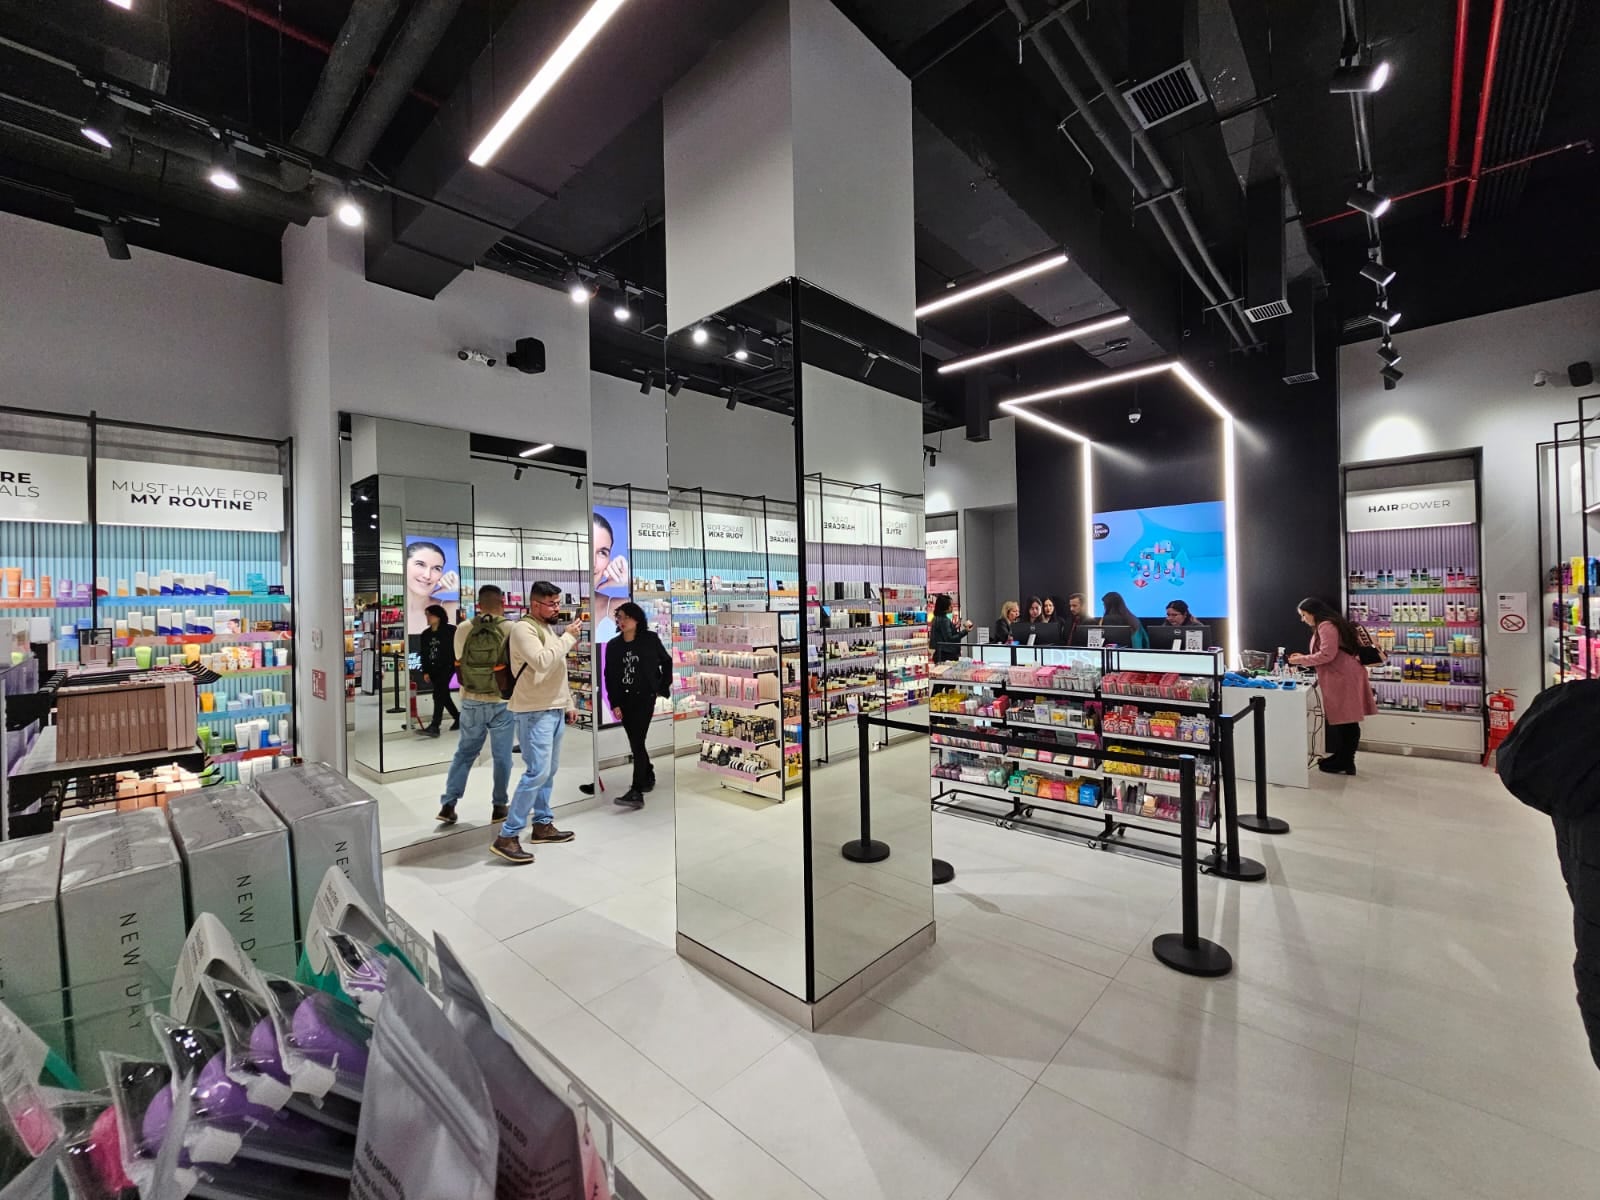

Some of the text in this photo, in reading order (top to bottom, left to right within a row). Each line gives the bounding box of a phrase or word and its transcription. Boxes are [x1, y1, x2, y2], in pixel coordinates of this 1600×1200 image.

[0, 471, 32, 484] RE
[0, 484, 40, 498] ALS
[112, 479, 269, 502] MUST-HAVE FOR
[131, 493, 253, 511] MY ROUTINE
[637, 529, 670, 537] SELECTI
[236, 875, 254, 922] NEW
[120, 912, 141, 966] NEW
